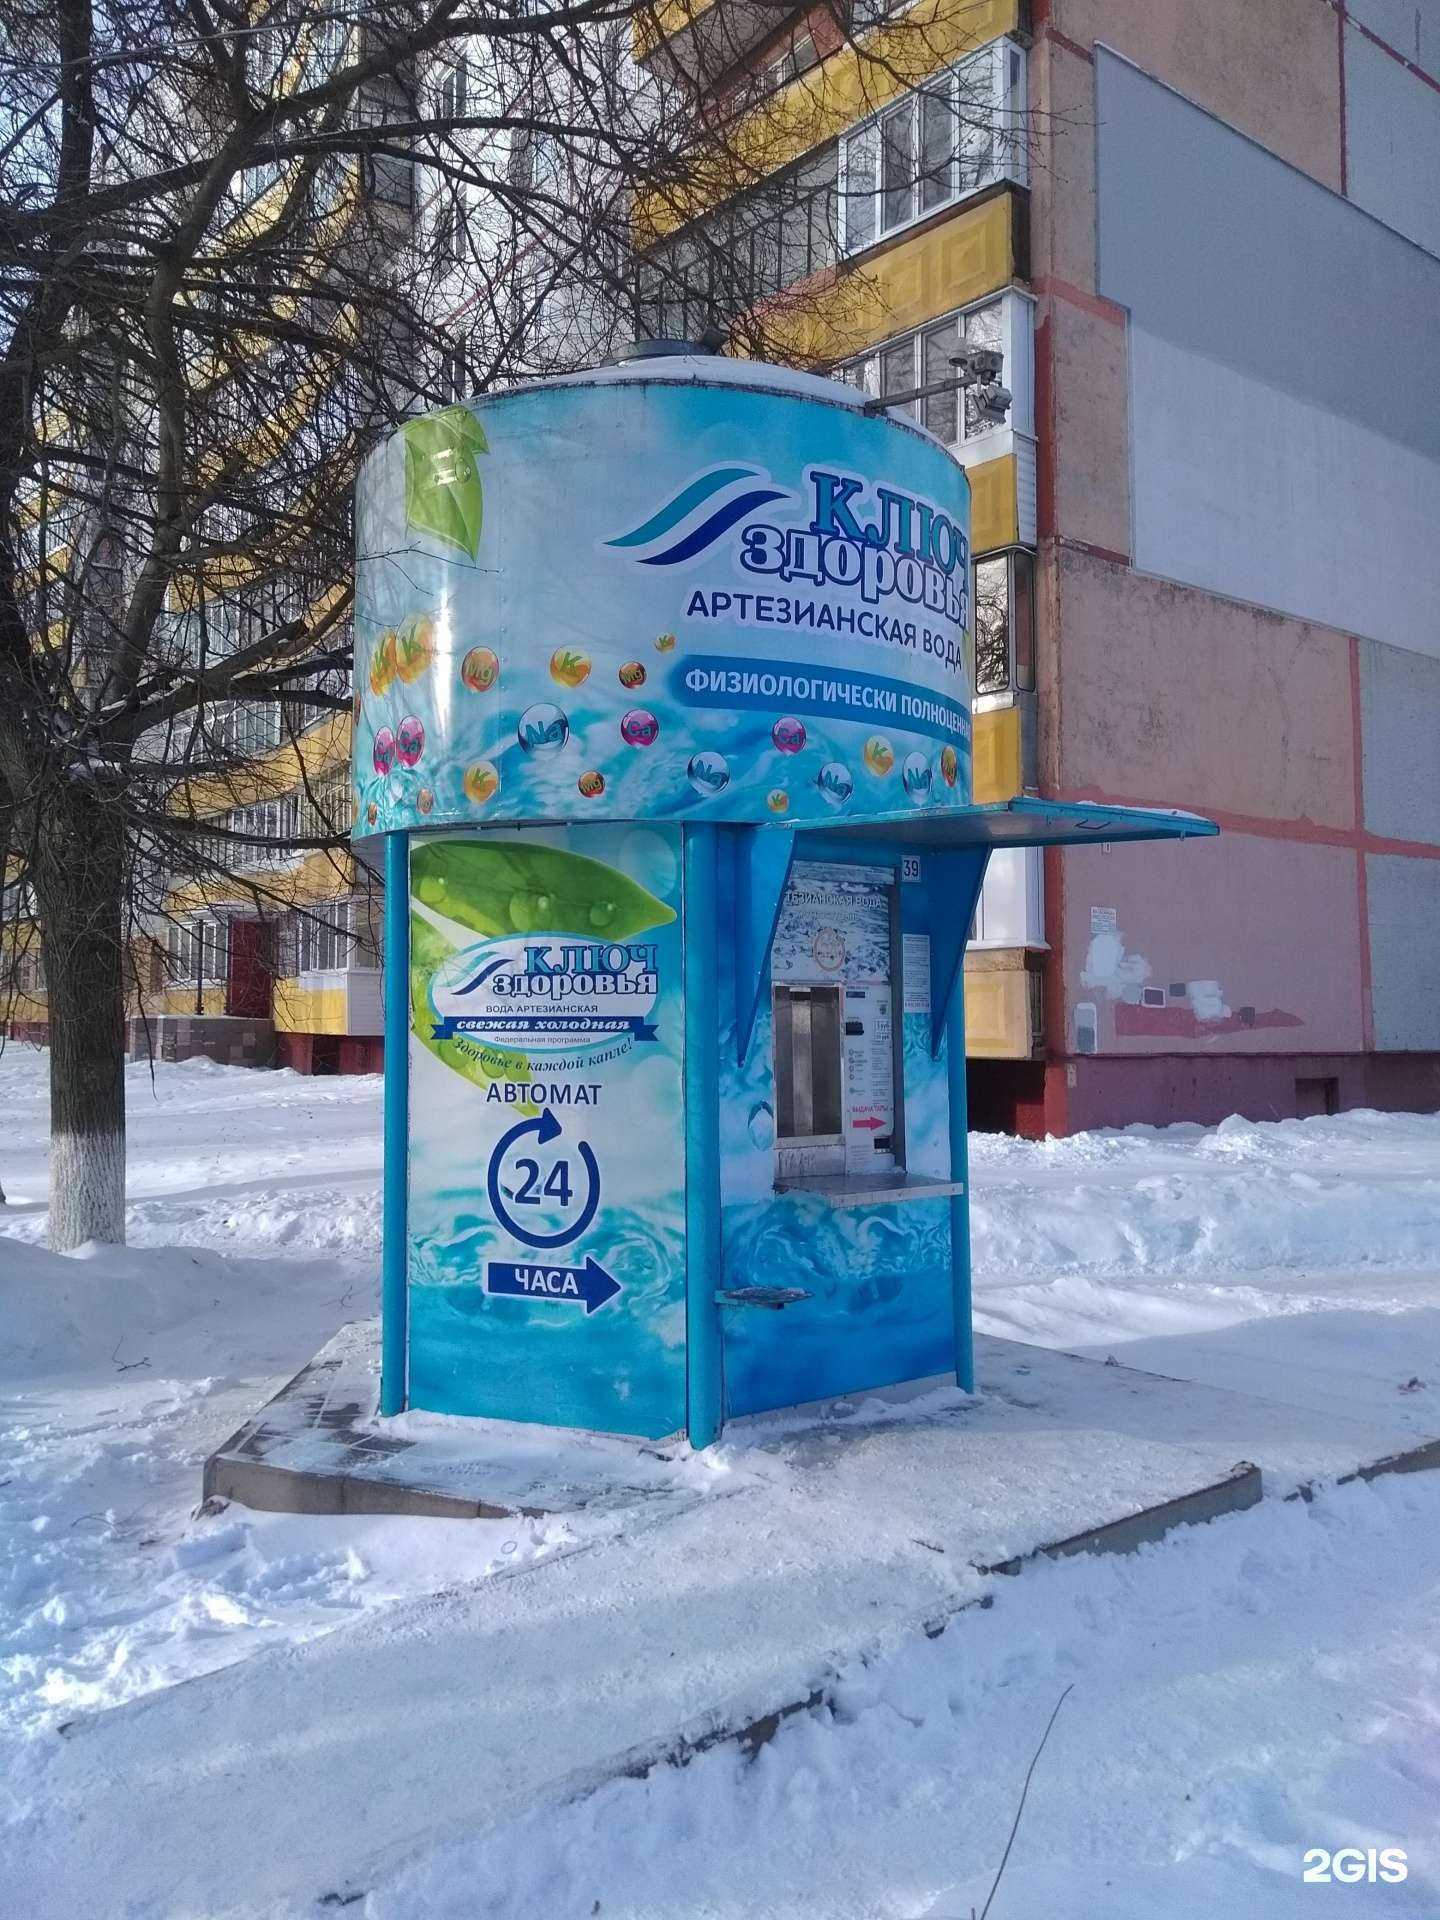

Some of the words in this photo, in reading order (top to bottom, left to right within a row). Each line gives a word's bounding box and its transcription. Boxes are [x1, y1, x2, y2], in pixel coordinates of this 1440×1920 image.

[687, 590, 916, 648] АРТЕЗИАНСКАЯ
[923, 628, 962, 674] ВОДА
[685, 669, 897, 712] ФИЗИОЛОГИЧЕСКИ
[904, 860, 919, 877] 39
[524, 944, 658, 975] КЛЮЧ
[486, 1004, 514, 1014] ВОДА
[516, 1004, 599, 1014] АРТЕЗИАНСКАЯ
[456, 1019, 530, 1030] свежая
[534, 1018, 631, 1030] холодная
[453, 1035, 513, 1069] Здоровье
[526, 1056, 584, 1072] каждой
[487, 1083, 602, 1105] АВТОМАТ
[514, 1158, 573, 1207] 24
[514, 1268, 579, 1295] ЧАСА
